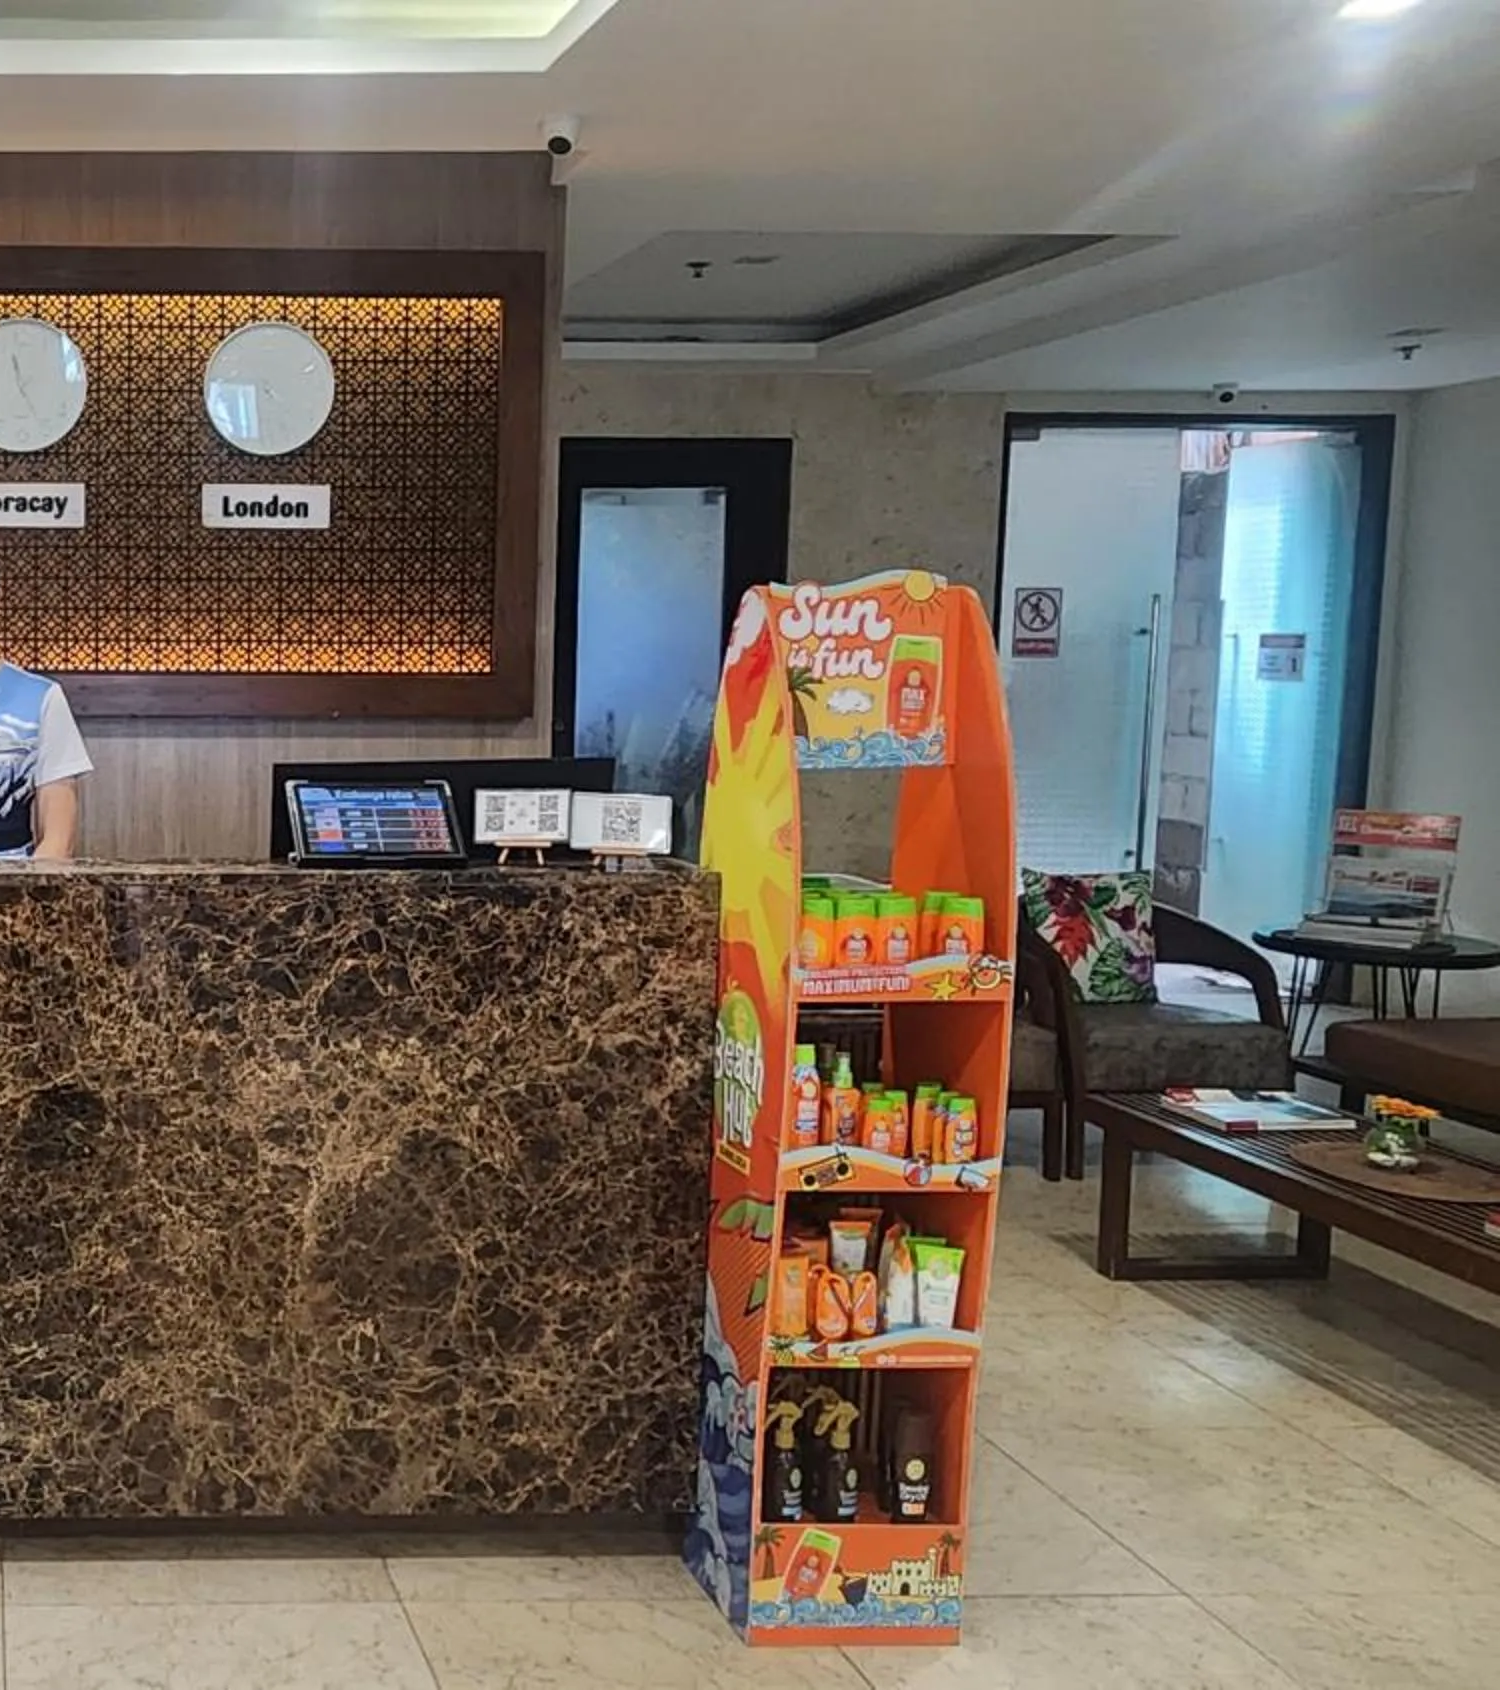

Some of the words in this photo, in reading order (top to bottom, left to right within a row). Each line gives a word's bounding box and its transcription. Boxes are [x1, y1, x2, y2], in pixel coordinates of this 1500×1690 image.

[223, 494, 309, 518] London
[778, 582, 893, 642] Sun
[788, 642, 812, 668] is
[811, 638, 885, 680] fun
[802, 978, 877, 996] MAXIMUM
[714, 1019, 765, 1106] Beach
[722, 1077, 755, 1149] Hut
